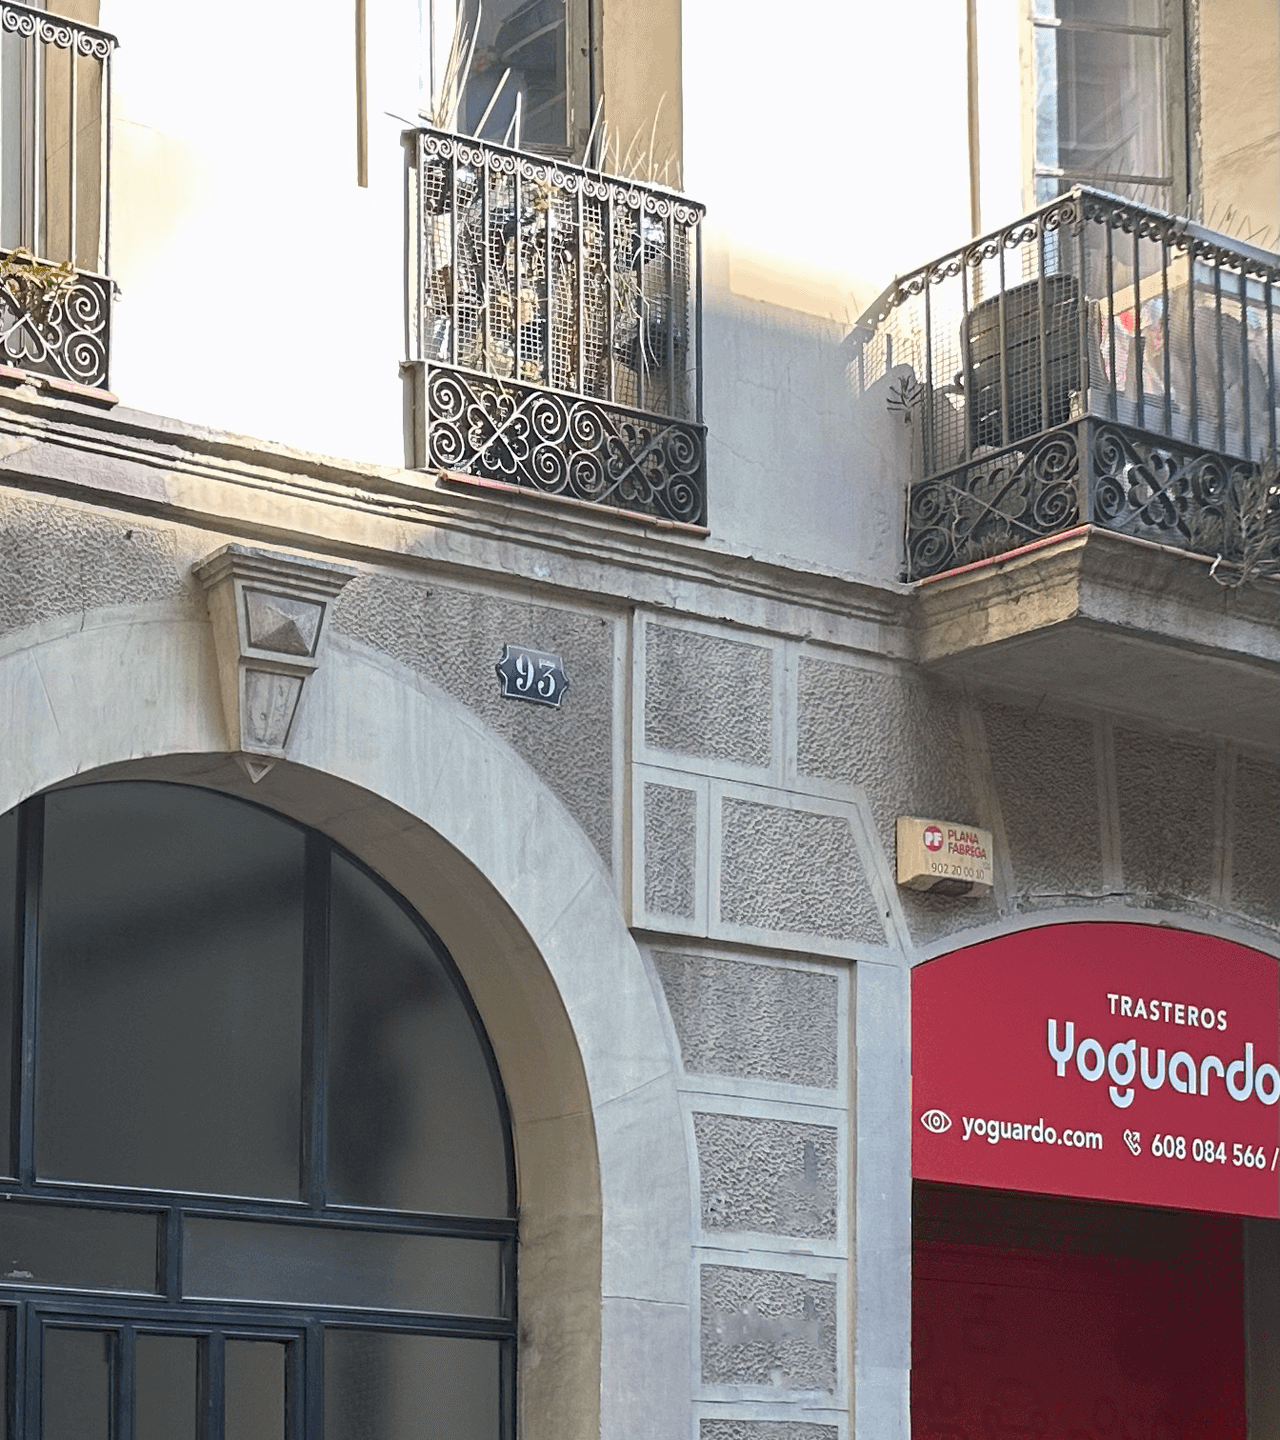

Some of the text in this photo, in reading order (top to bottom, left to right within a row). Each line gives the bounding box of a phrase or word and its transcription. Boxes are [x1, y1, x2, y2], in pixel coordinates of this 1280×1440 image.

[516, 653, 556, 698] 93
[925, 831, 942, 847] PF
[947, 829, 979, 845] PLANA
[947, 842, 987, 860] FABREGA
[931, 862, 950, 875] 902
[951, 864, 962, 876] 20
[963, 866, 974, 878] 00
[975, 868, 985, 880] 10
[1108, 994, 1227, 1030] TRASTEROS
[1047, 1018, 1280, 1109] Yoguardo
[963, 1117, 1102, 1149] yoguardo.com
[1152, 1134, 1279, 1171] 608 084 566 /
